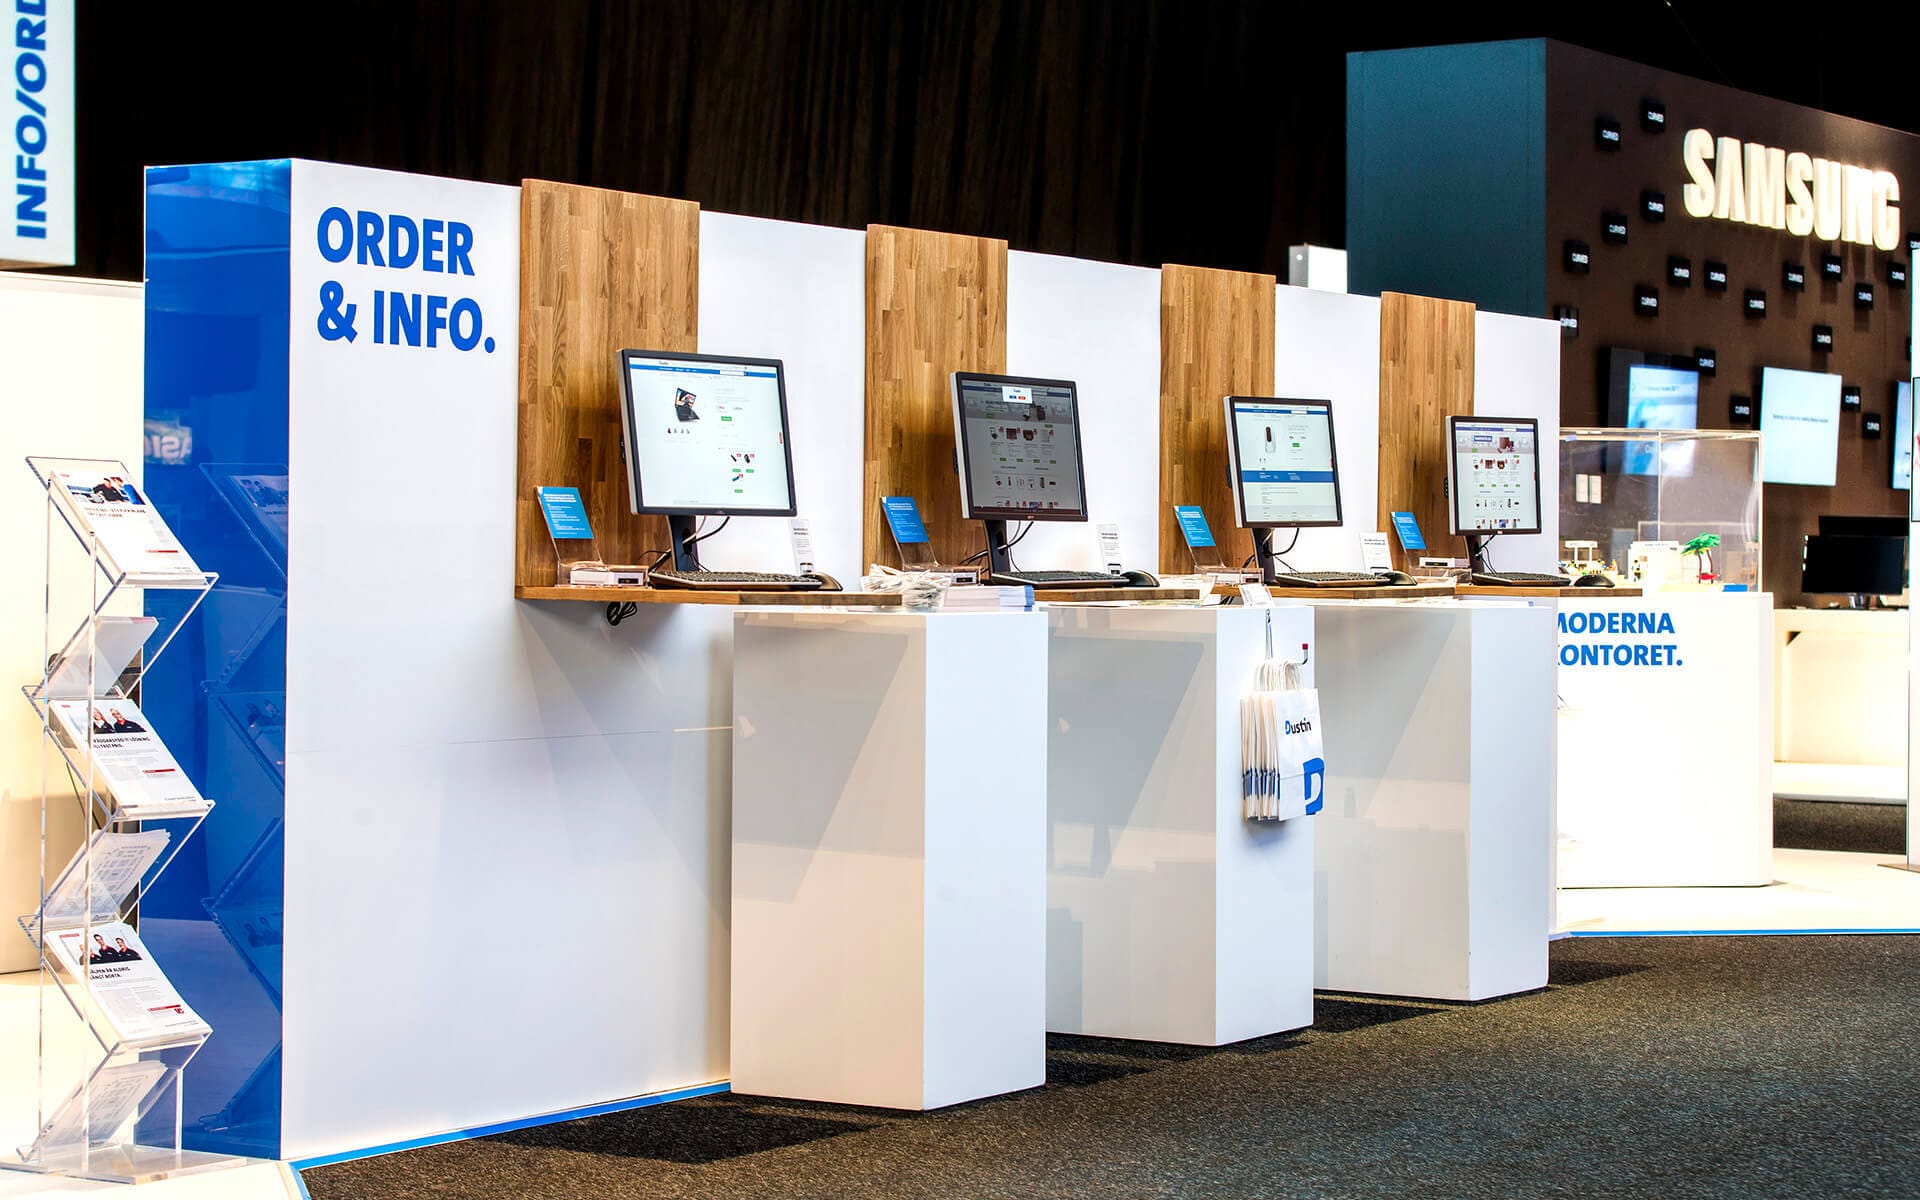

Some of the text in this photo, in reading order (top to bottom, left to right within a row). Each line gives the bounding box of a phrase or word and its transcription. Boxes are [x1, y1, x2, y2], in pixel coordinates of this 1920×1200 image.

[1683, 128, 1900, 251] SAMSUNG
[317, 206, 475, 276] ORDER
[317, 280, 496, 353] & INFO.
[1558, 644, 1683, 666] ONTORET.
[1285, 717, 1312, 735] Dustin
